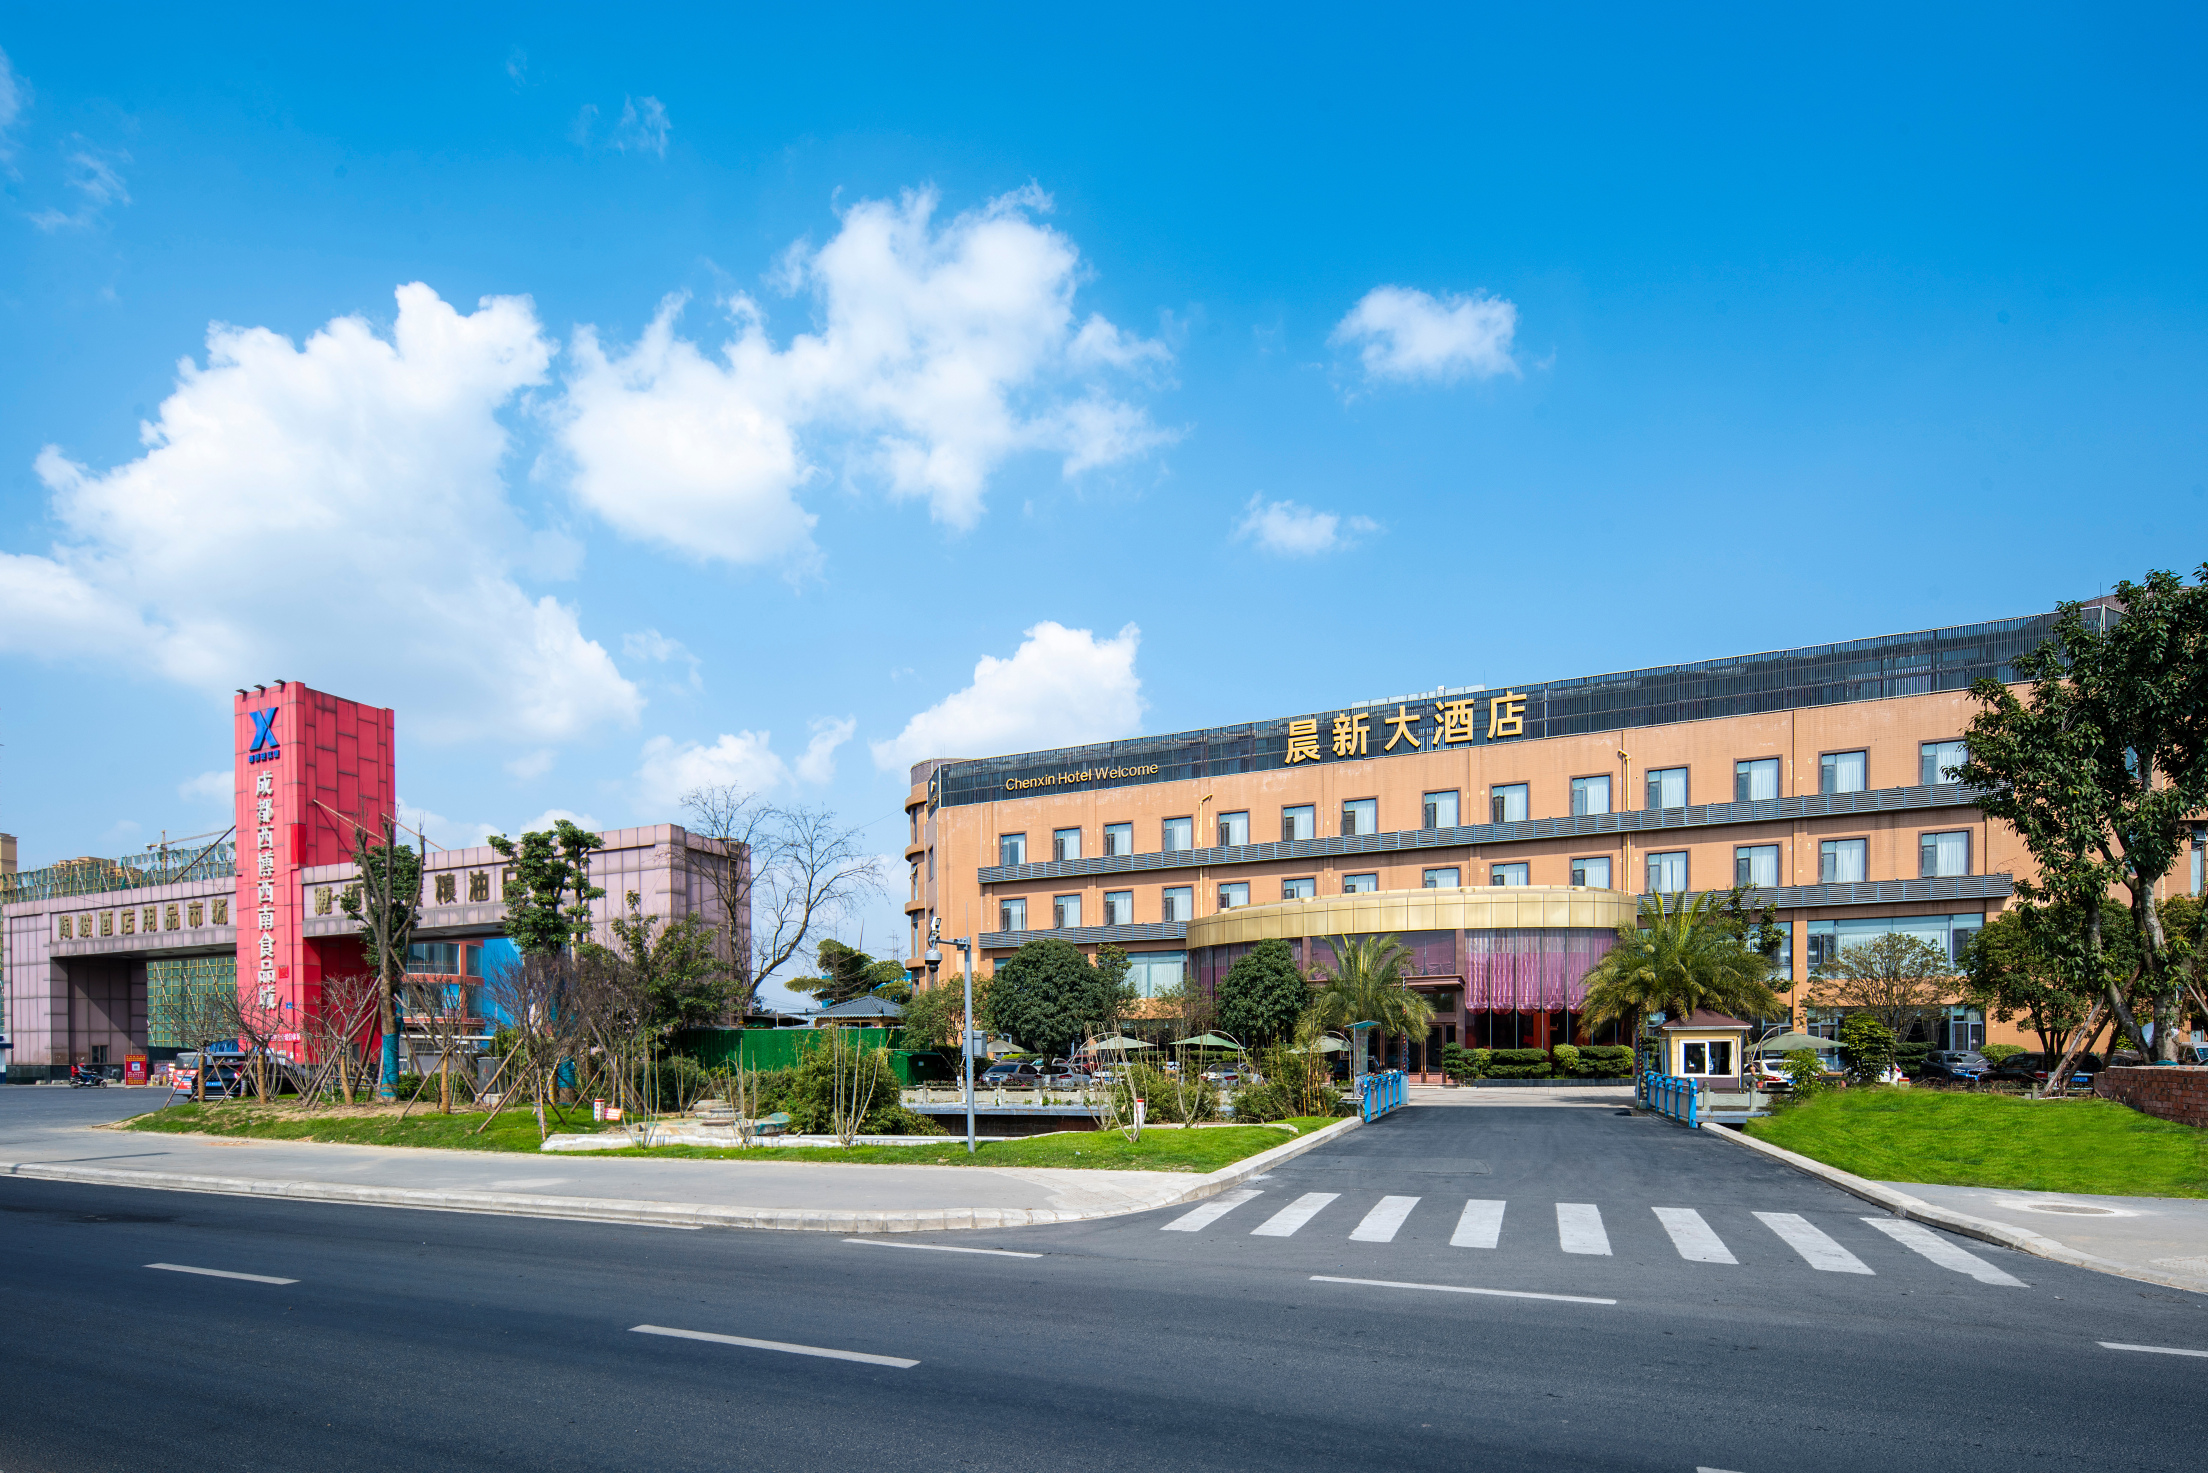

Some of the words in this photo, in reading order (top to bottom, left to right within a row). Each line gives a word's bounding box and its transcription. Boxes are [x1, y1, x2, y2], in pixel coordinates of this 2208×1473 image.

[1284, 690, 1527, 765] 晨新大酒店
[1005, 774, 1056, 791] Chenxin
[1057, 768, 1092, 785] Hotel
[1094, 763, 1159, 780] Welcome
[58, 898, 228, 940] 陶玻酒店用品市场
[255, 770, 278, 1011] 成都西博西南食品城
